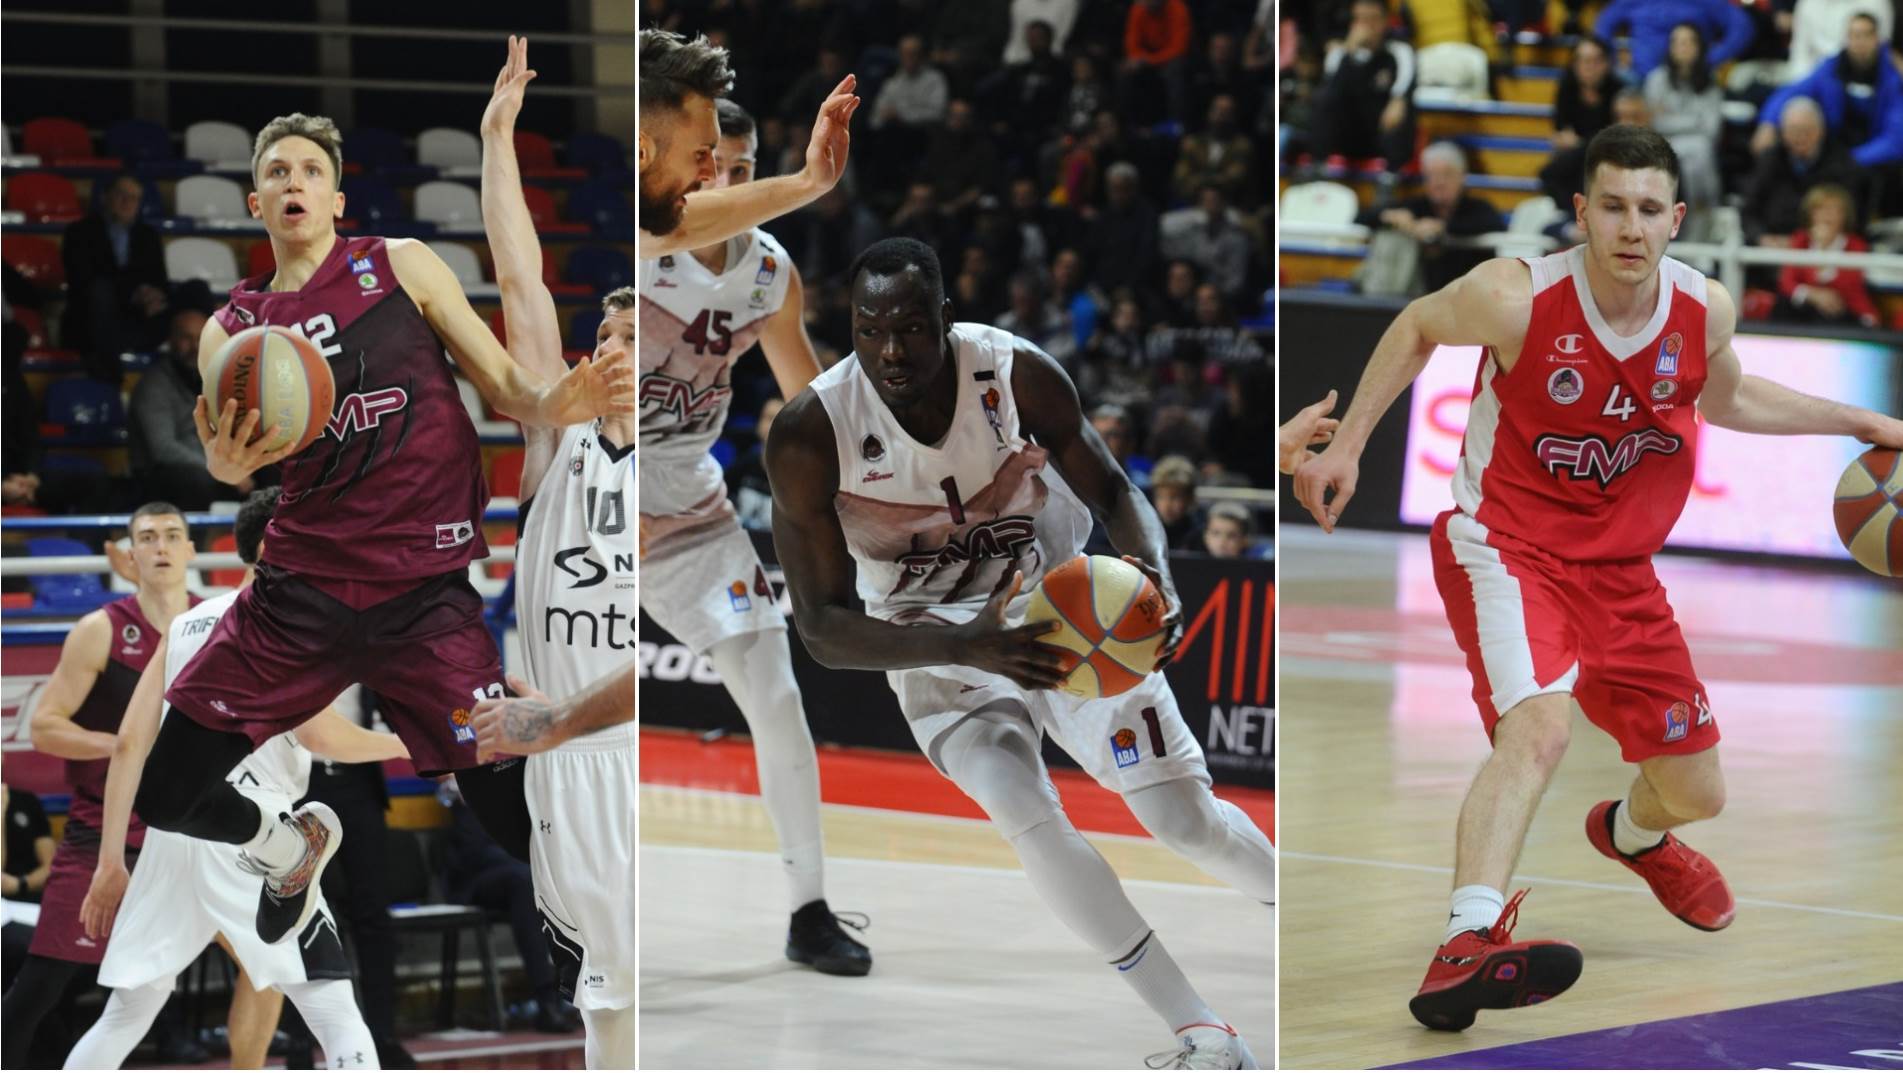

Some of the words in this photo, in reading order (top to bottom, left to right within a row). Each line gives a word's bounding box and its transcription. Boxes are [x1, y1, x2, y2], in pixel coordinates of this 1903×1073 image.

[682, 309, 732, 355] 45
[1657, 355, 1676, 372] ABA
[1602, 384, 1637, 421] 4
[1535, 428, 1682, 488] FMP
[587, 487, 626, 535] 10
[940, 475, 966, 525] 1
[1208, 706, 1275, 754] NET
[1695, 692, 1713, 727] 4
[456, 726, 475, 742] ABA
[1141, 707, 1166, 758] 1
[1666, 724, 1685, 740] ABA
[1117, 749, 1138, 768] ABA
